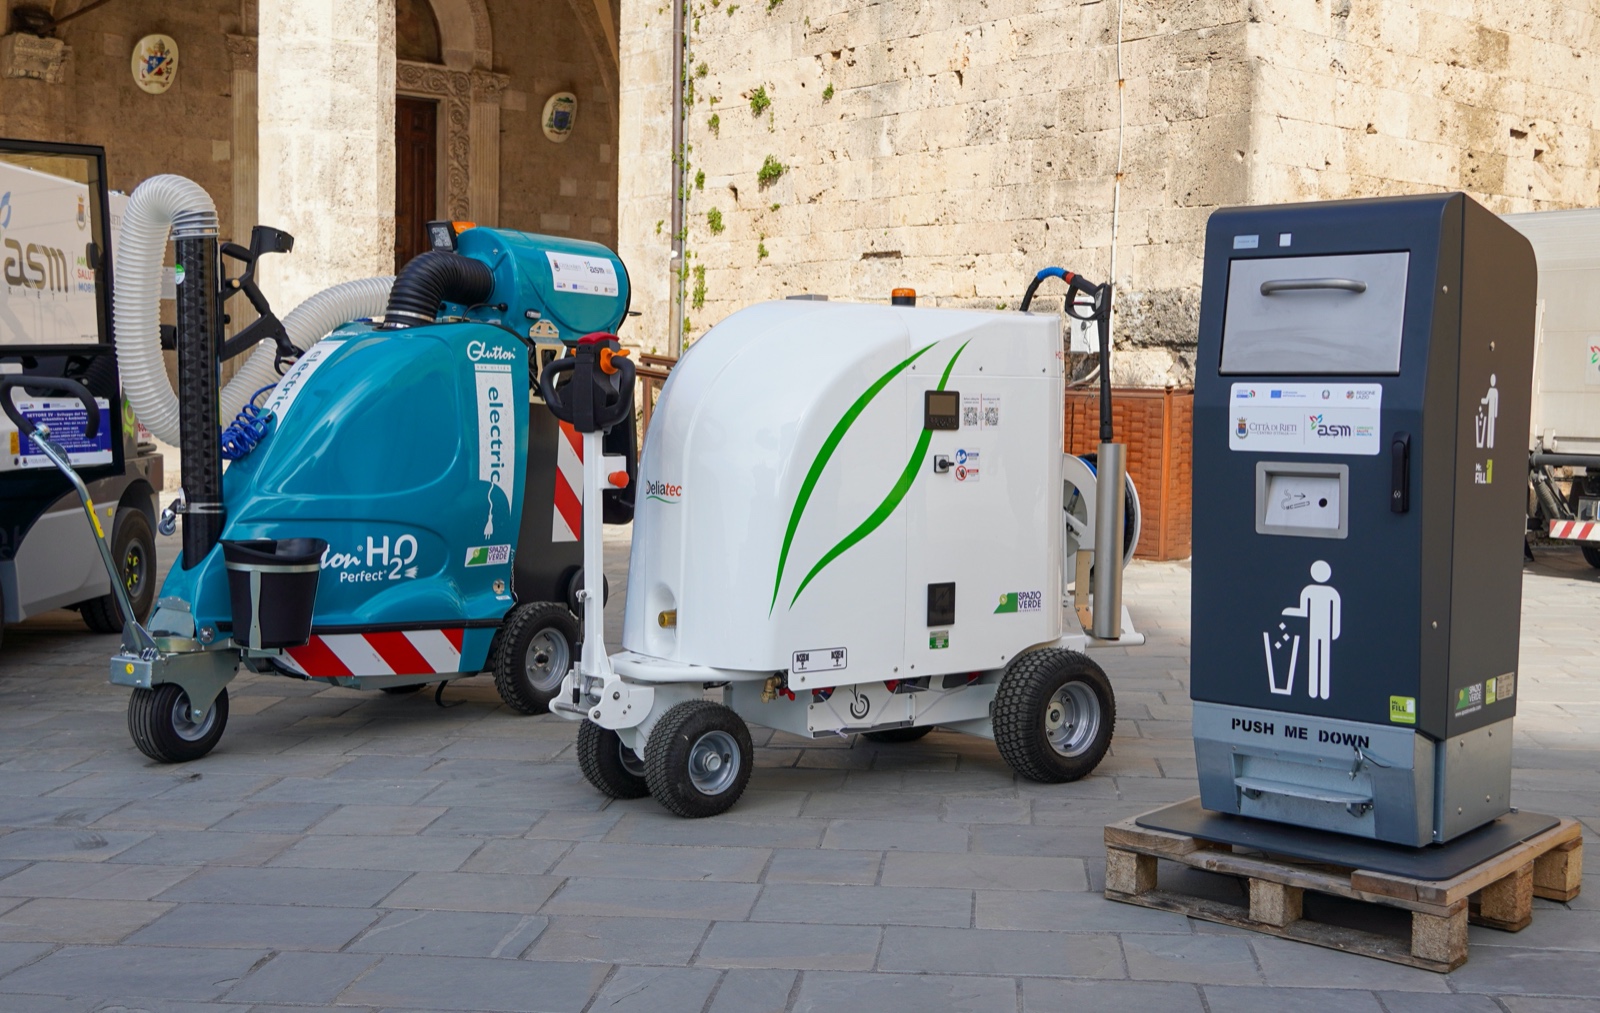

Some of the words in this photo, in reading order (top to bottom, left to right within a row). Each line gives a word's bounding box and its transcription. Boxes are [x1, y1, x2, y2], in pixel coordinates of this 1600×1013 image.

[4, 238, 69, 293] asm
[77, 269, 96, 280] SALUT
[467, 340, 516, 361] Glutton
[271, 350, 321, 411] electric
[1279, 423, 1297, 432] RIETI
[1317, 425, 1351, 437] asm
[488, 387, 504, 482] electric
[646, 480, 682, 497] Deliatec
[489, 545, 508, 554] SPAZIO
[488, 553, 508, 561] VERDE
[340, 571, 383, 583] Perfect
[1018, 591, 1042, 600] SPAZIO
[1018, 600, 1041, 609] VERDE
[1392, 705, 1406, 713] FILL
[1231, 718, 1274, 736] PUSH
[1284, 725, 1308, 740] ME
[1318, 730, 1370, 749] DOWN
